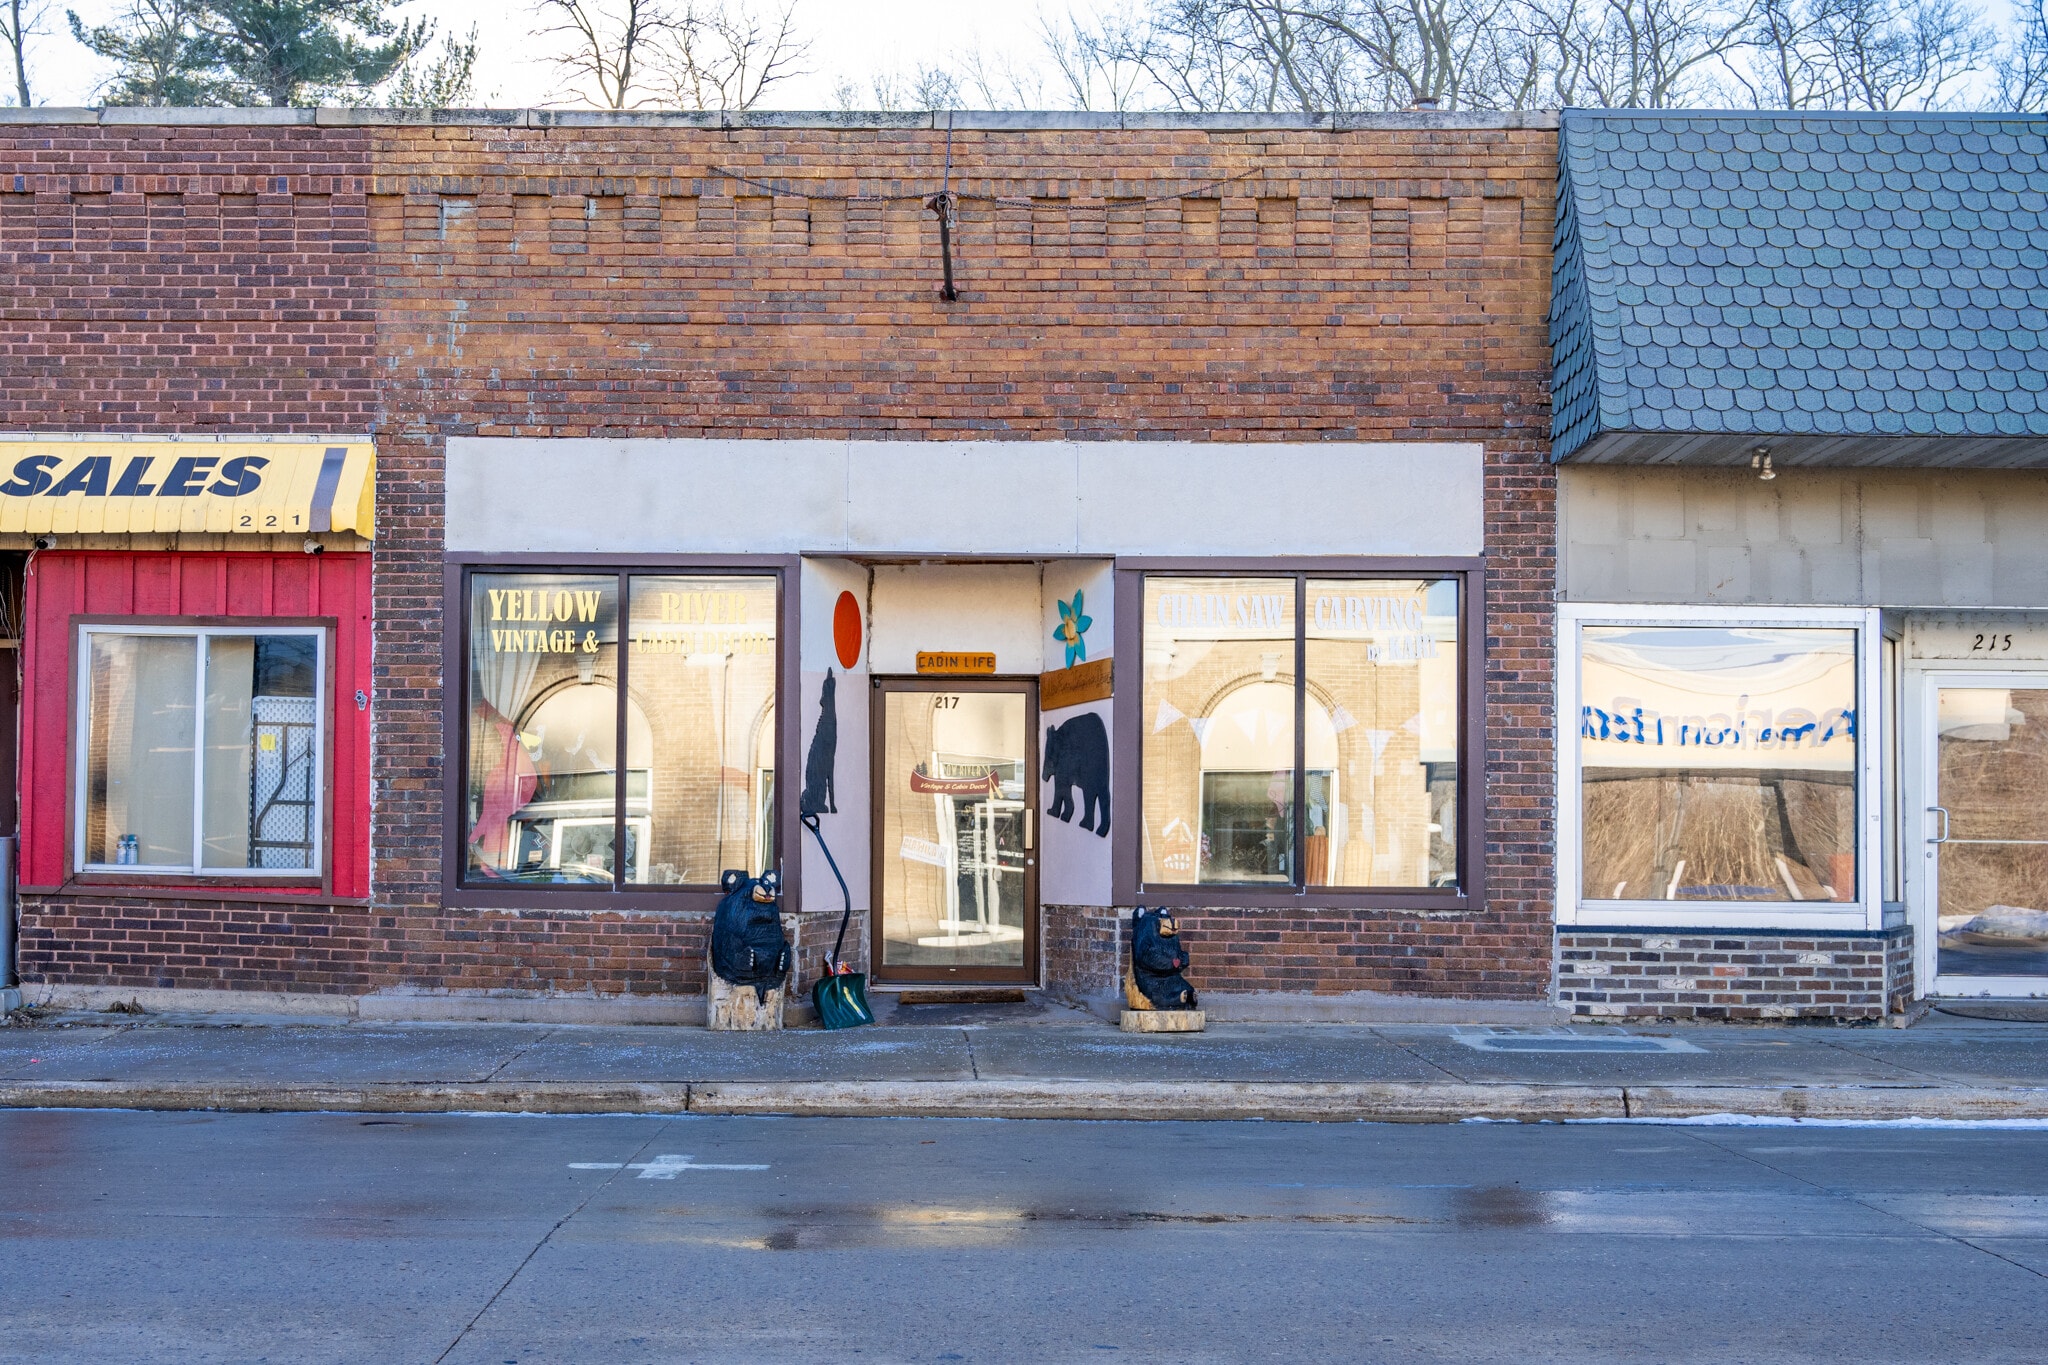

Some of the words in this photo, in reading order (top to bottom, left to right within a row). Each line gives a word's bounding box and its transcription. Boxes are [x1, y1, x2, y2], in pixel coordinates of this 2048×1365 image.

[0, 455, 270, 496] SALES
[240, 514, 300, 526] 221
[488, 589, 601, 622] YELLOW
[661, 592, 747, 624] RIVER
[1157, 593, 1230, 628] CHAIN
[1235, 594, 1285, 628] SAW
[1314, 596, 1422, 631] CARVING
[492, 629, 576, 653] VINTAGE
[582, 630, 599, 653] &
[636, 631, 696, 654] CABIN
[703, 632, 770, 654] DECOR
[1389, 634, 1440, 660] KARL
[1972, 634, 2013, 651] 215
[918, 656, 958, 668] CABIN
[964, 656, 994, 668] LIFE
[935, 696, 960, 709] 217
[920, 783, 944, 791] Vintage
